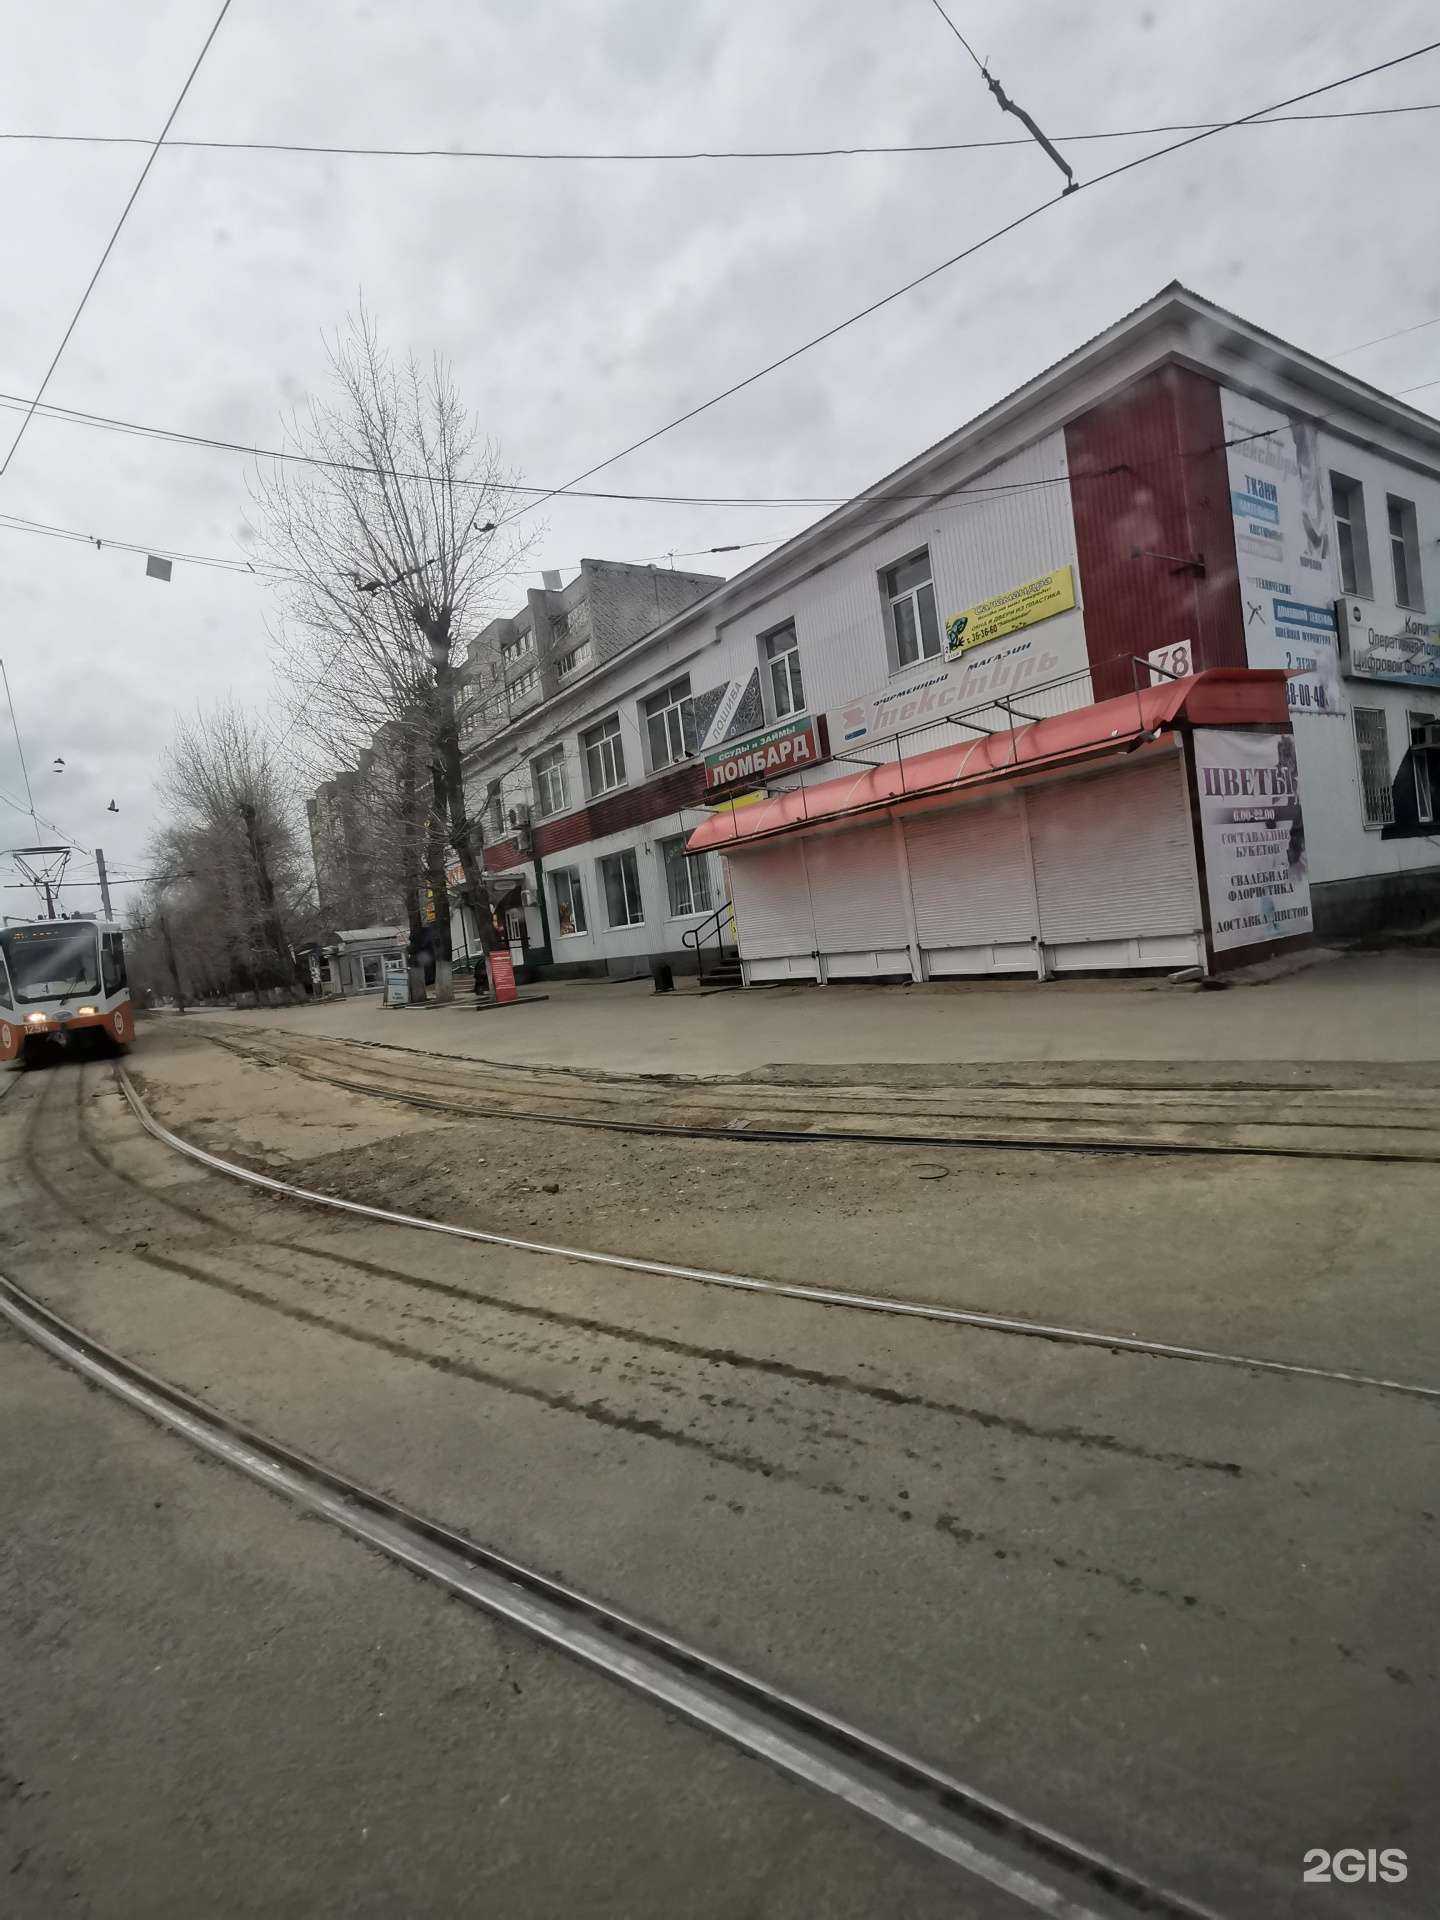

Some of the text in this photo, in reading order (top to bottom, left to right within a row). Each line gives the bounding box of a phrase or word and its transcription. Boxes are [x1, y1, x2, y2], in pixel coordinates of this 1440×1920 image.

[1157, 647, 1187, 682] 78
[713, 682, 742, 740] ПОШИВА
[712, 735, 811, 787] ЛОМБАРД
[1203, 767, 1294, 801] ЦВЕТЫ
[1230, 870, 1289, 887] СВАДЕБНАЯ
[1216, 911, 1269, 934] ДОСТАВКА
